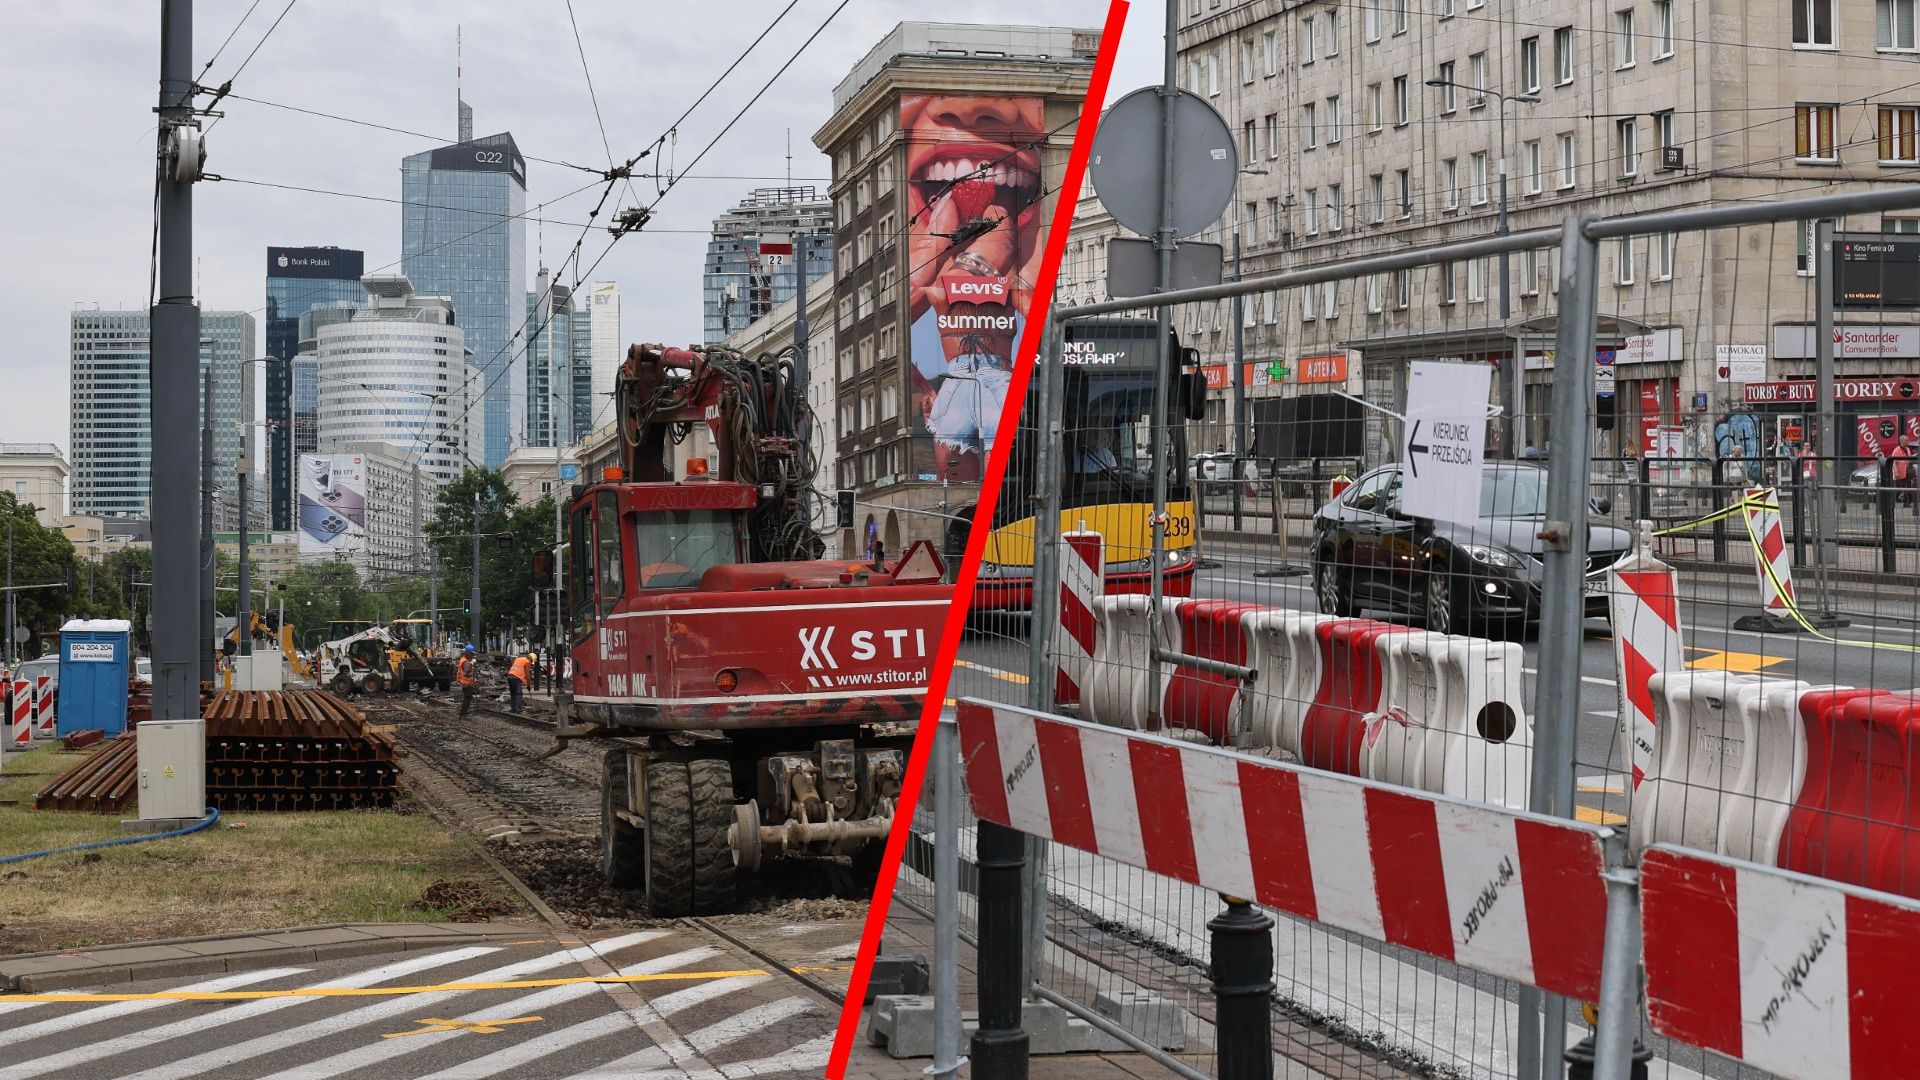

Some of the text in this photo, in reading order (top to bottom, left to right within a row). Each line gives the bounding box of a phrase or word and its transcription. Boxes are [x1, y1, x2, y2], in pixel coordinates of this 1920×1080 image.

[475, 151, 503, 164] Q22
[1854, 244, 1866, 252] Kino
[291, 258, 330, 266] Bank Polski
[769, 255, 783, 265] 22
[595, 295, 611, 305] EY
[938, 314, 1015, 330] summer
[1844, 331, 1899, 343] Santander
[1718, 346, 1765, 355] ADWOKACI
[1844, 345, 1899, 353] Consumer Bank
[1307, 361, 1337, 378] APTEKA
[1746, 384, 1815, 400] TORBY BUTY
[1833, 382, 1897, 398] TORBY
[1433, 422, 1470, 442] KIERUNEK
[1432, 444, 1472, 465] PRZEJŚCIA
[650, 486, 736, 510] ATLAS
[1149, 516, 1190, 538] 239
[851, 628, 926, 661] STI
[836, 667, 927, 685] www.stitor.pl
[607, 673, 648, 697] 1404 MK
